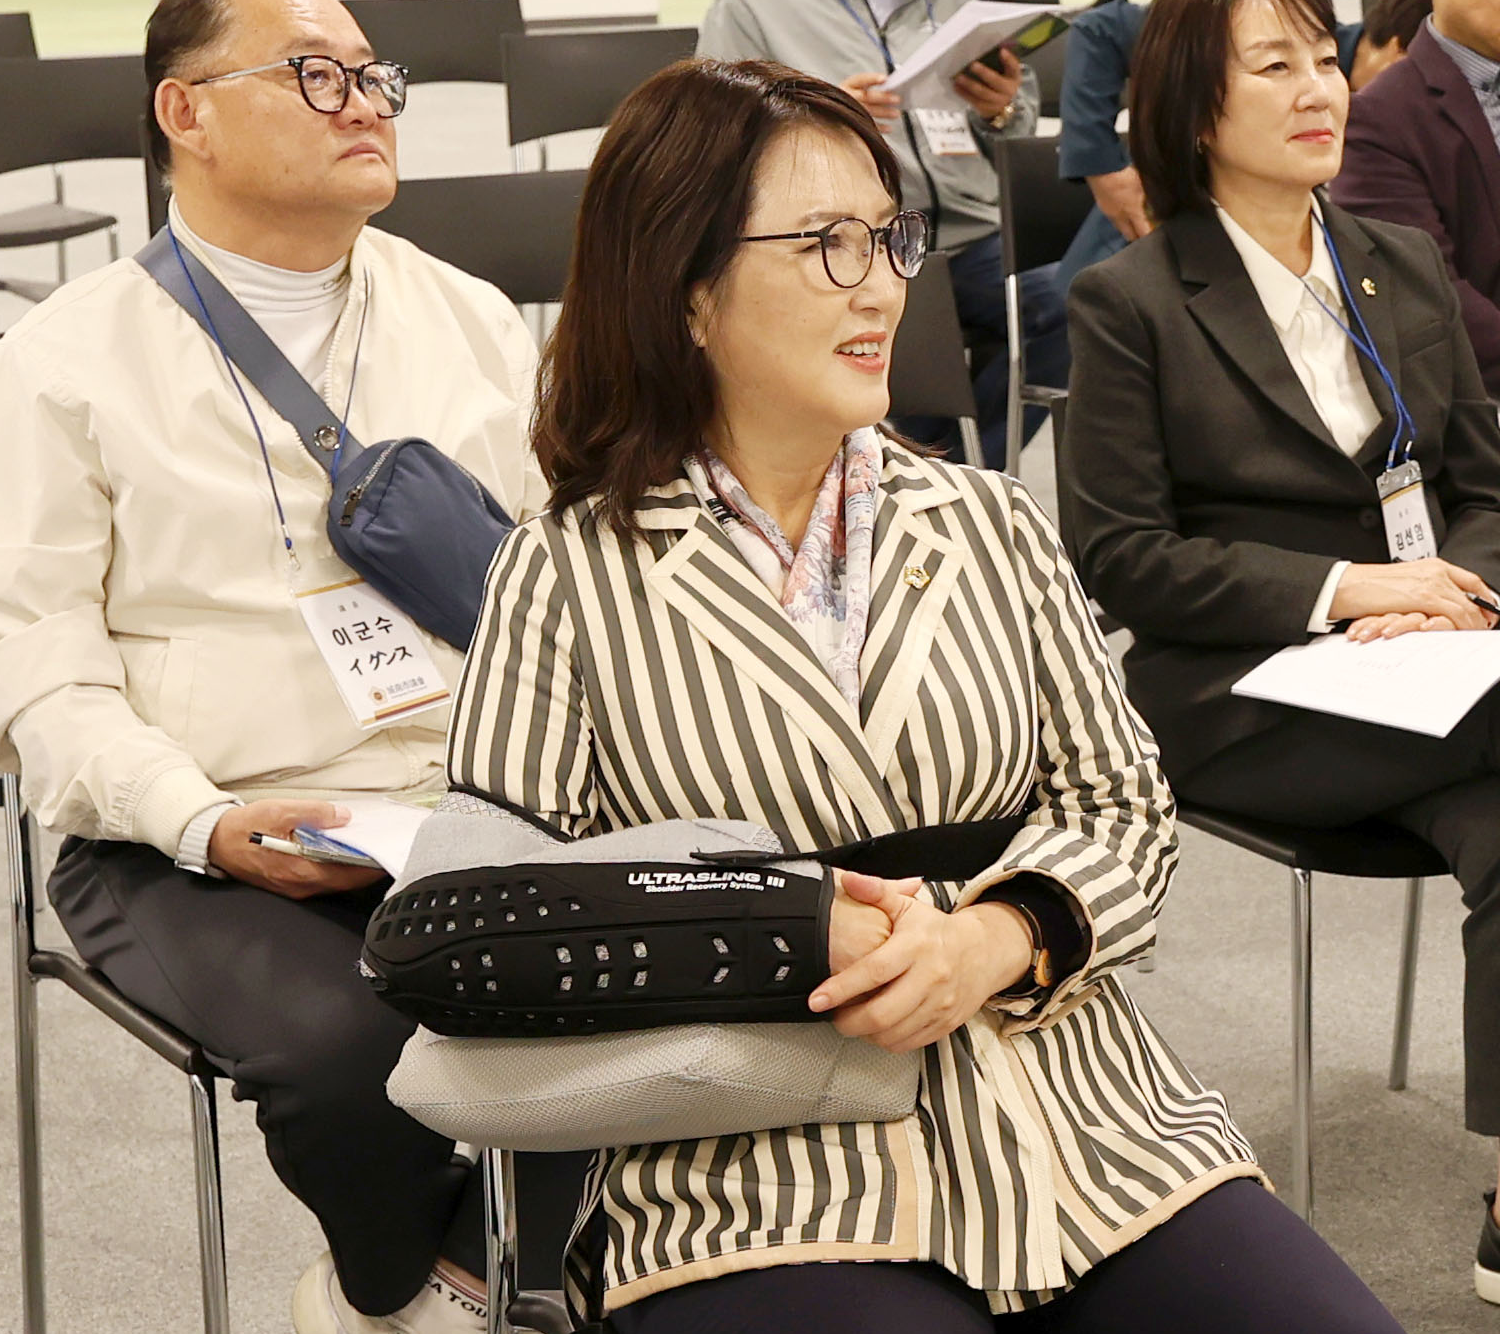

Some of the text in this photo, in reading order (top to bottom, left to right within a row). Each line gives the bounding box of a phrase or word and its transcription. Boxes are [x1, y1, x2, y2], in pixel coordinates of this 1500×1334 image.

[331, 615, 394, 647] 이군수
[628, 872, 787, 889] ULTRASLING III
[644, 880, 765, 893] Shoulder Recovery System
